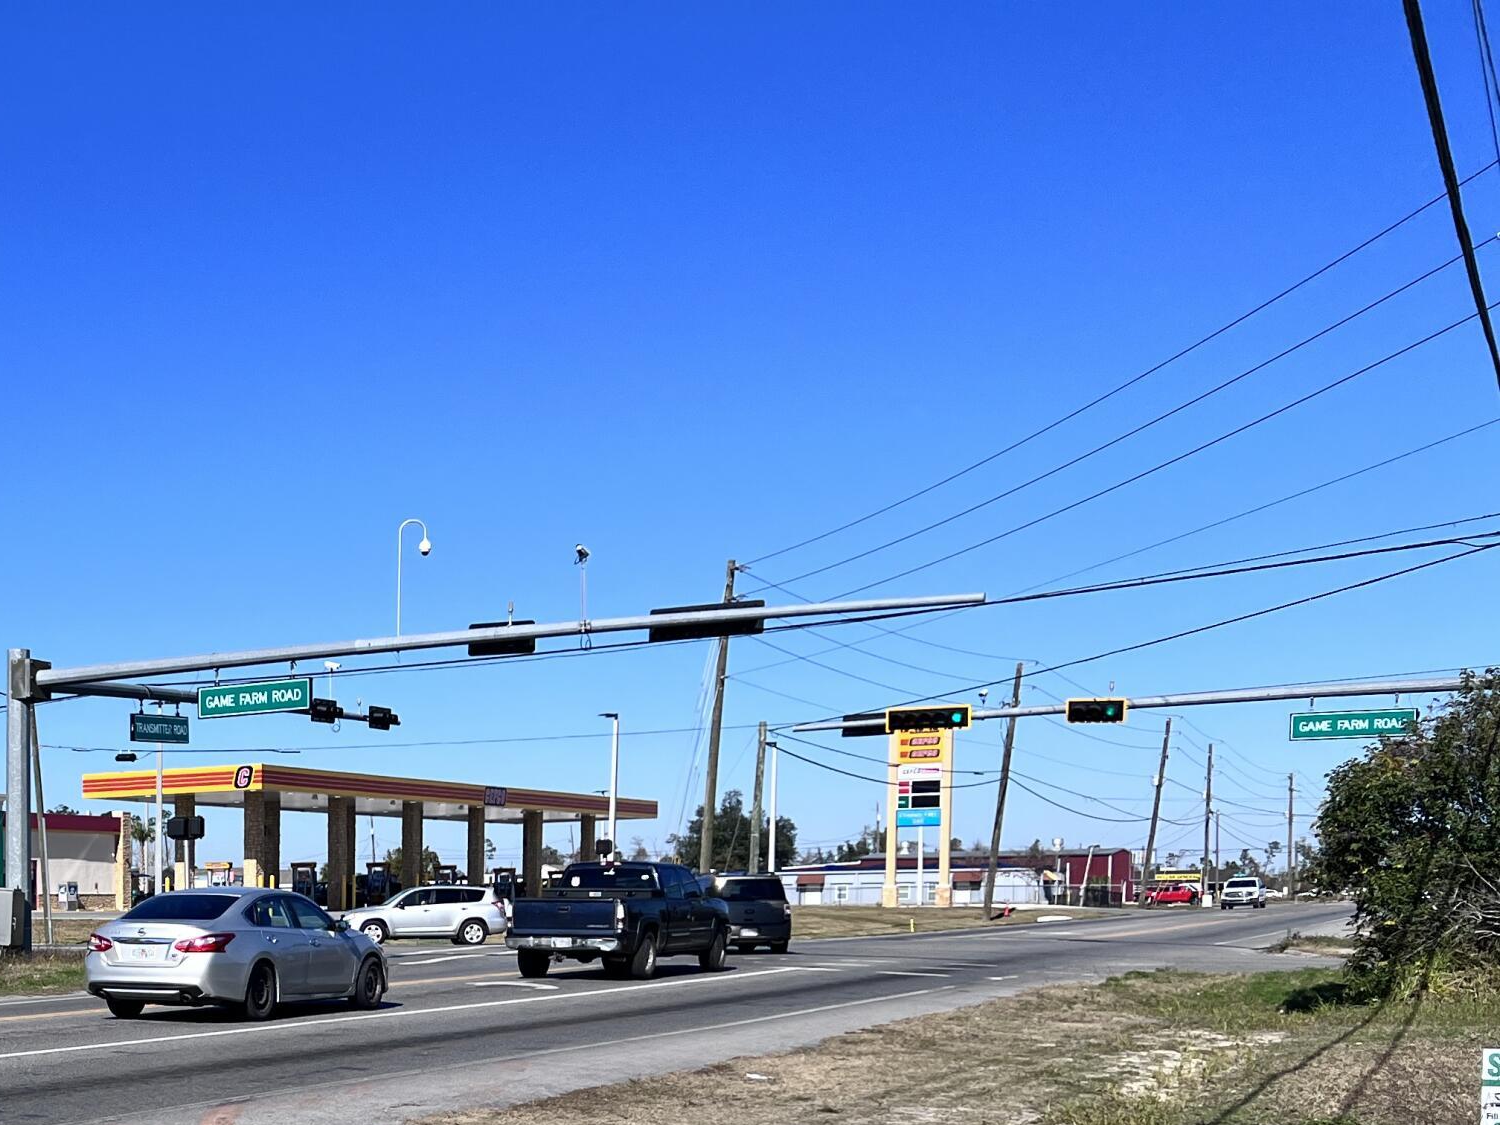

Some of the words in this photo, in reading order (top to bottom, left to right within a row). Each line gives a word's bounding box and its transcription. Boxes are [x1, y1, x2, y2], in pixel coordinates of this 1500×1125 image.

[205, 694, 235, 709] GAME
[239, 692, 268, 706] FARM
[271, 688, 302, 702] ROAD
[136, 722, 172, 735] TRANSMITTER
[173, 724, 188, 736] ROAD
[1299, 720, 1332, 732] GAME
[1337, 719, 1369, 730] FARM
[237, 768, 250, 786] C
